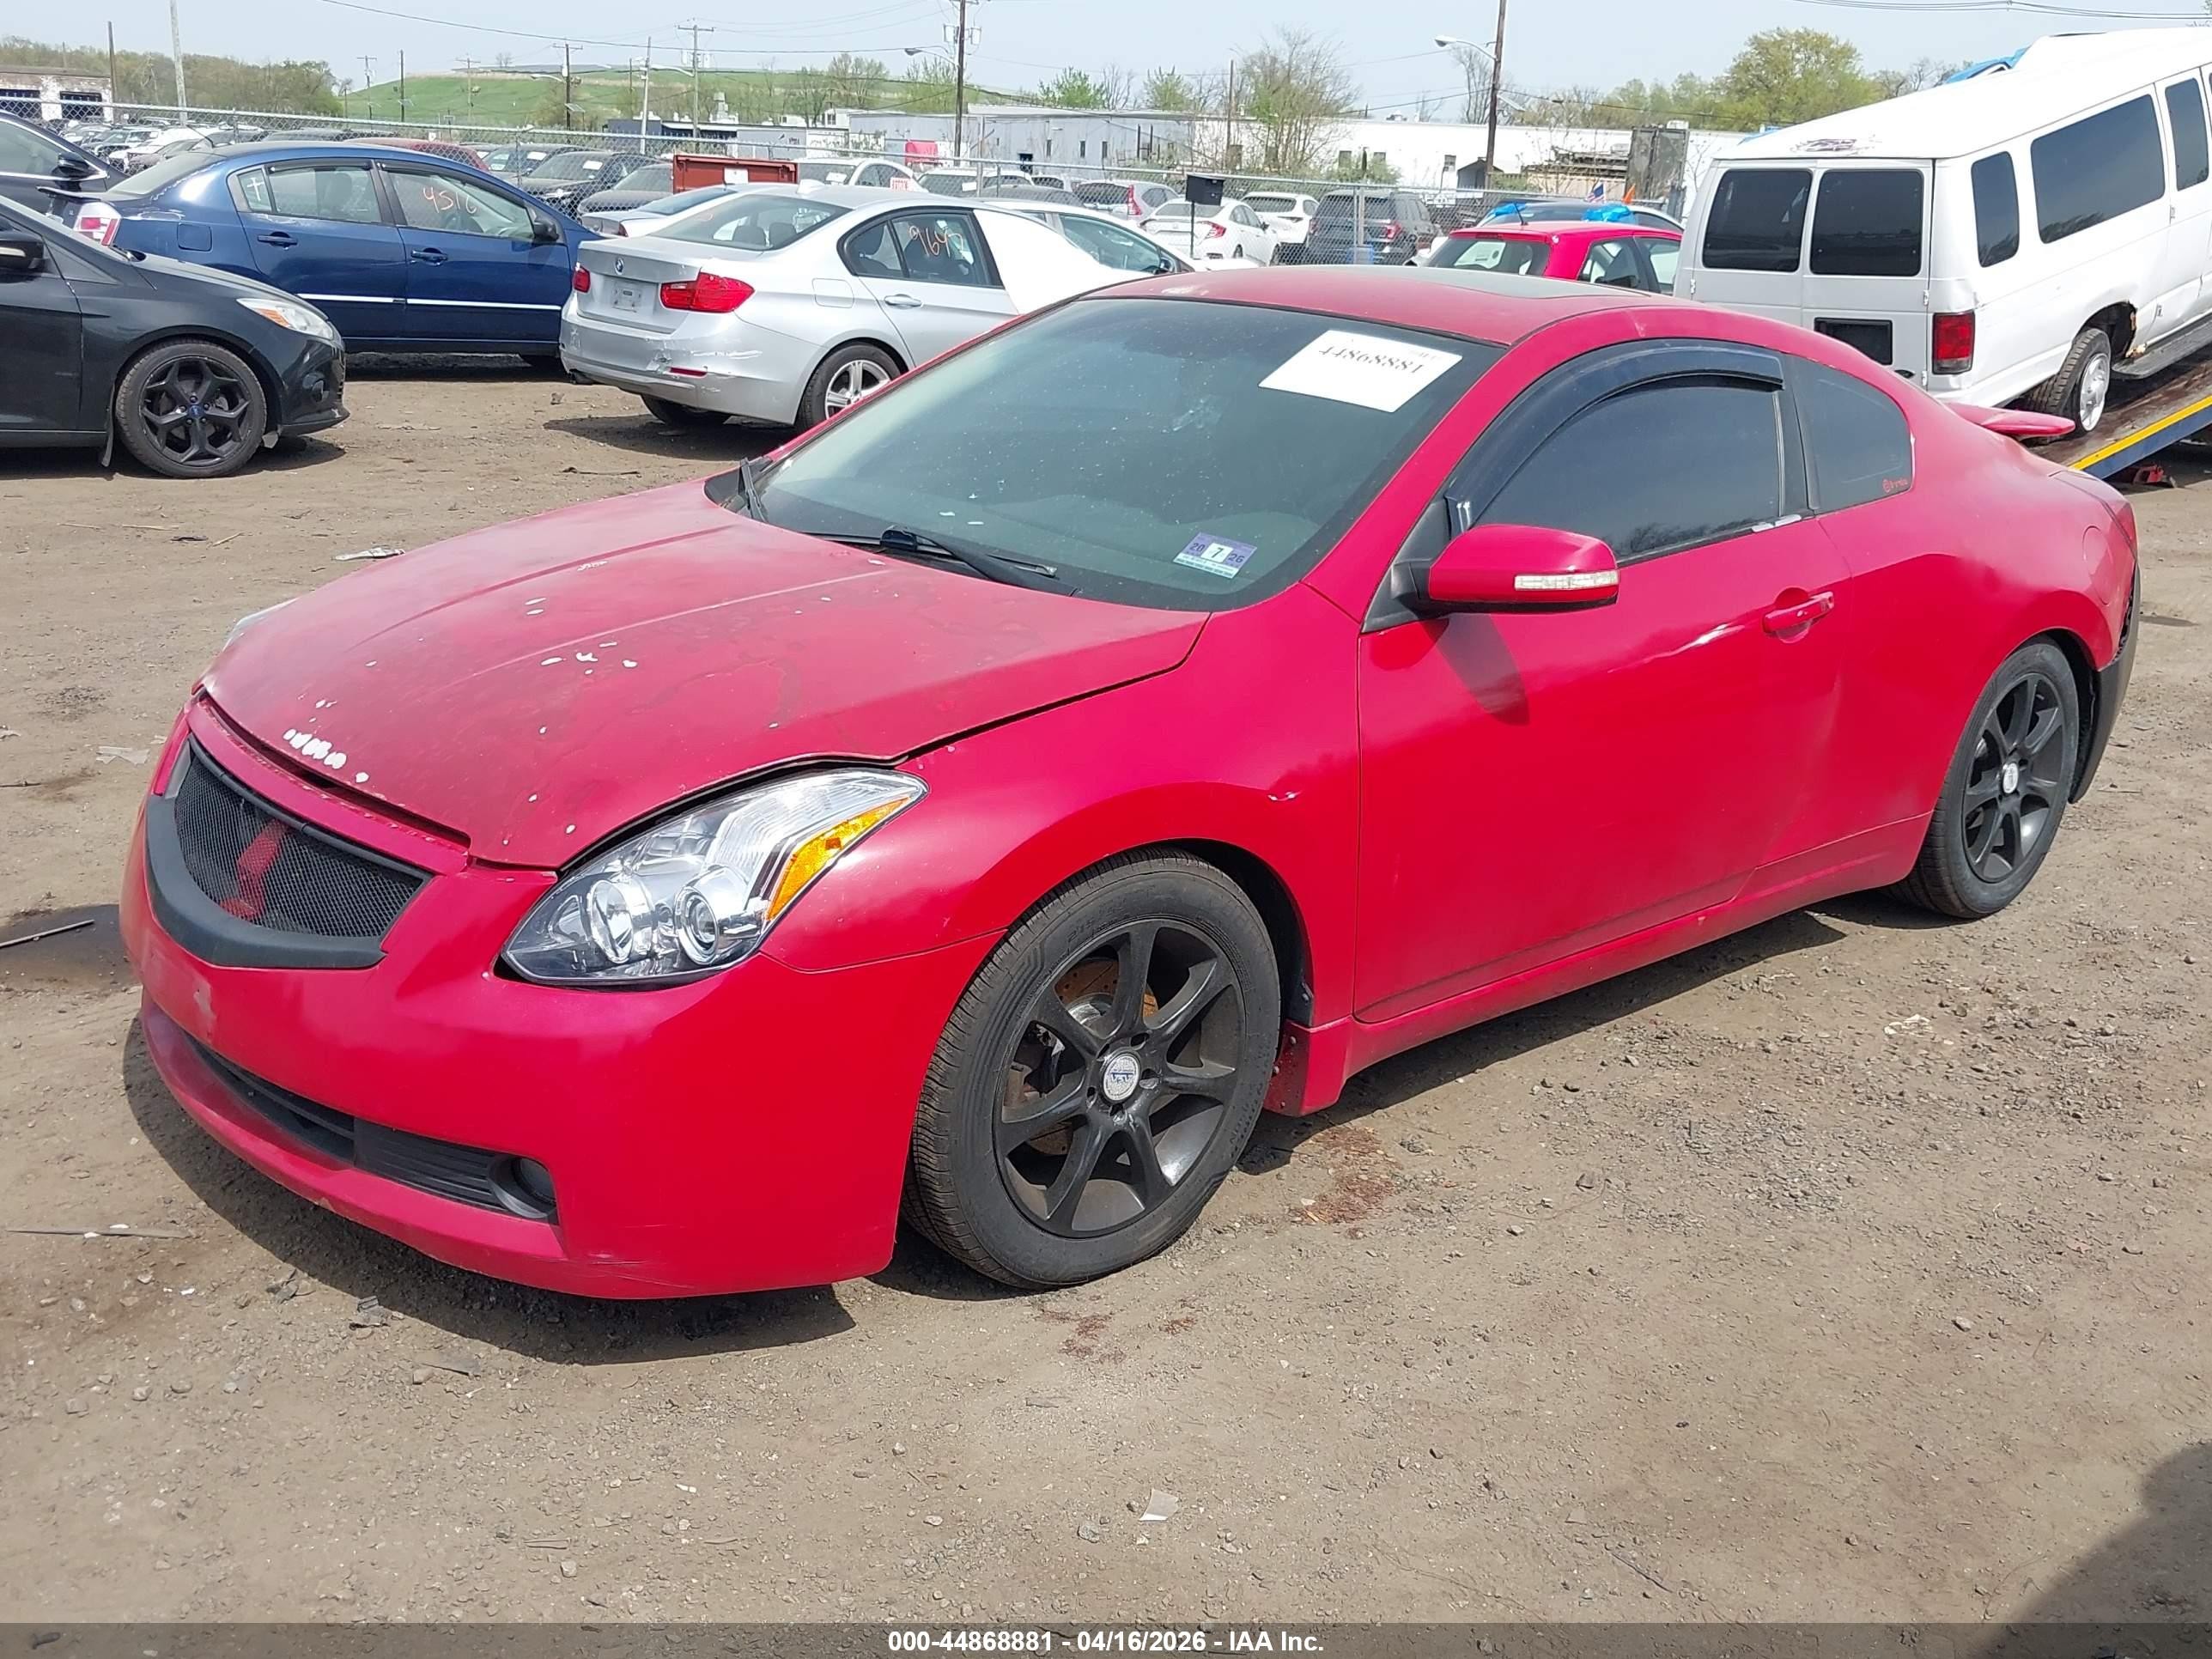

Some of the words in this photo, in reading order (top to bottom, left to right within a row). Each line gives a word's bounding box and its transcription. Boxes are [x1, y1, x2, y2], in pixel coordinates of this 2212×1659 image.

[422, 186, 477, 214] 4516
[1318, 345, 1425, 374] 44868881
[1189, 542, 1206, 553] 20
[1211, 547, 1224, 558] 7
[1227, 553, 1245, 563] 26
